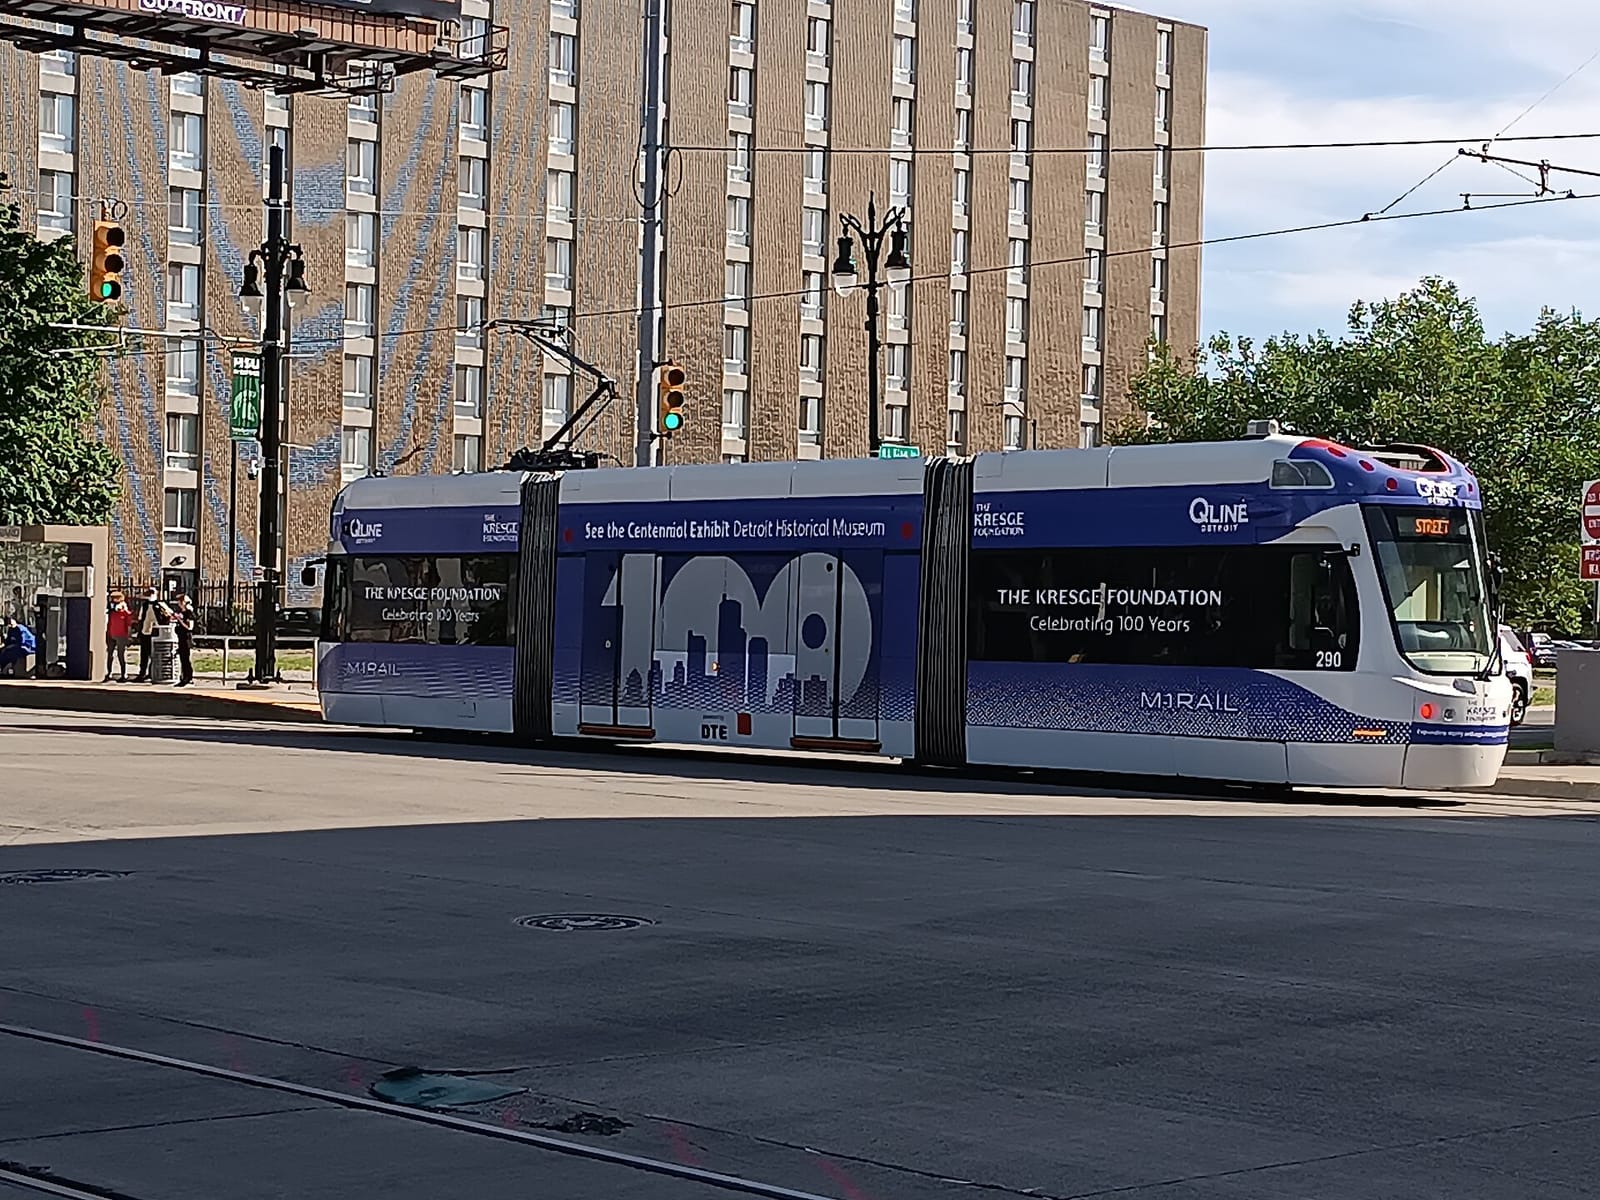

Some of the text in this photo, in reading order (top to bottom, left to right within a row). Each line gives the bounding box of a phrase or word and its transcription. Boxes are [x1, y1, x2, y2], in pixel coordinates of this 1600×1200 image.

[974, 512, 1025, 526] KRESGE
[1189, 497, 1249, 523] QLINE
[584, 518, 885, 539] See the Centennial Exhibit Detroit Historical Museum
[365, 587, 501, 601] THE KRESGE FOUNDATION
[997, 588, 1222, 606] THE KRESGE FOUNDATION
[382, 608, 480, 626] Celebrating 100 Years
[1030, 615, 1191, 636] Celebrating 100 Years
[1315, 650, 1342, 668] 290
[701, 723, 728, 740] DTE
